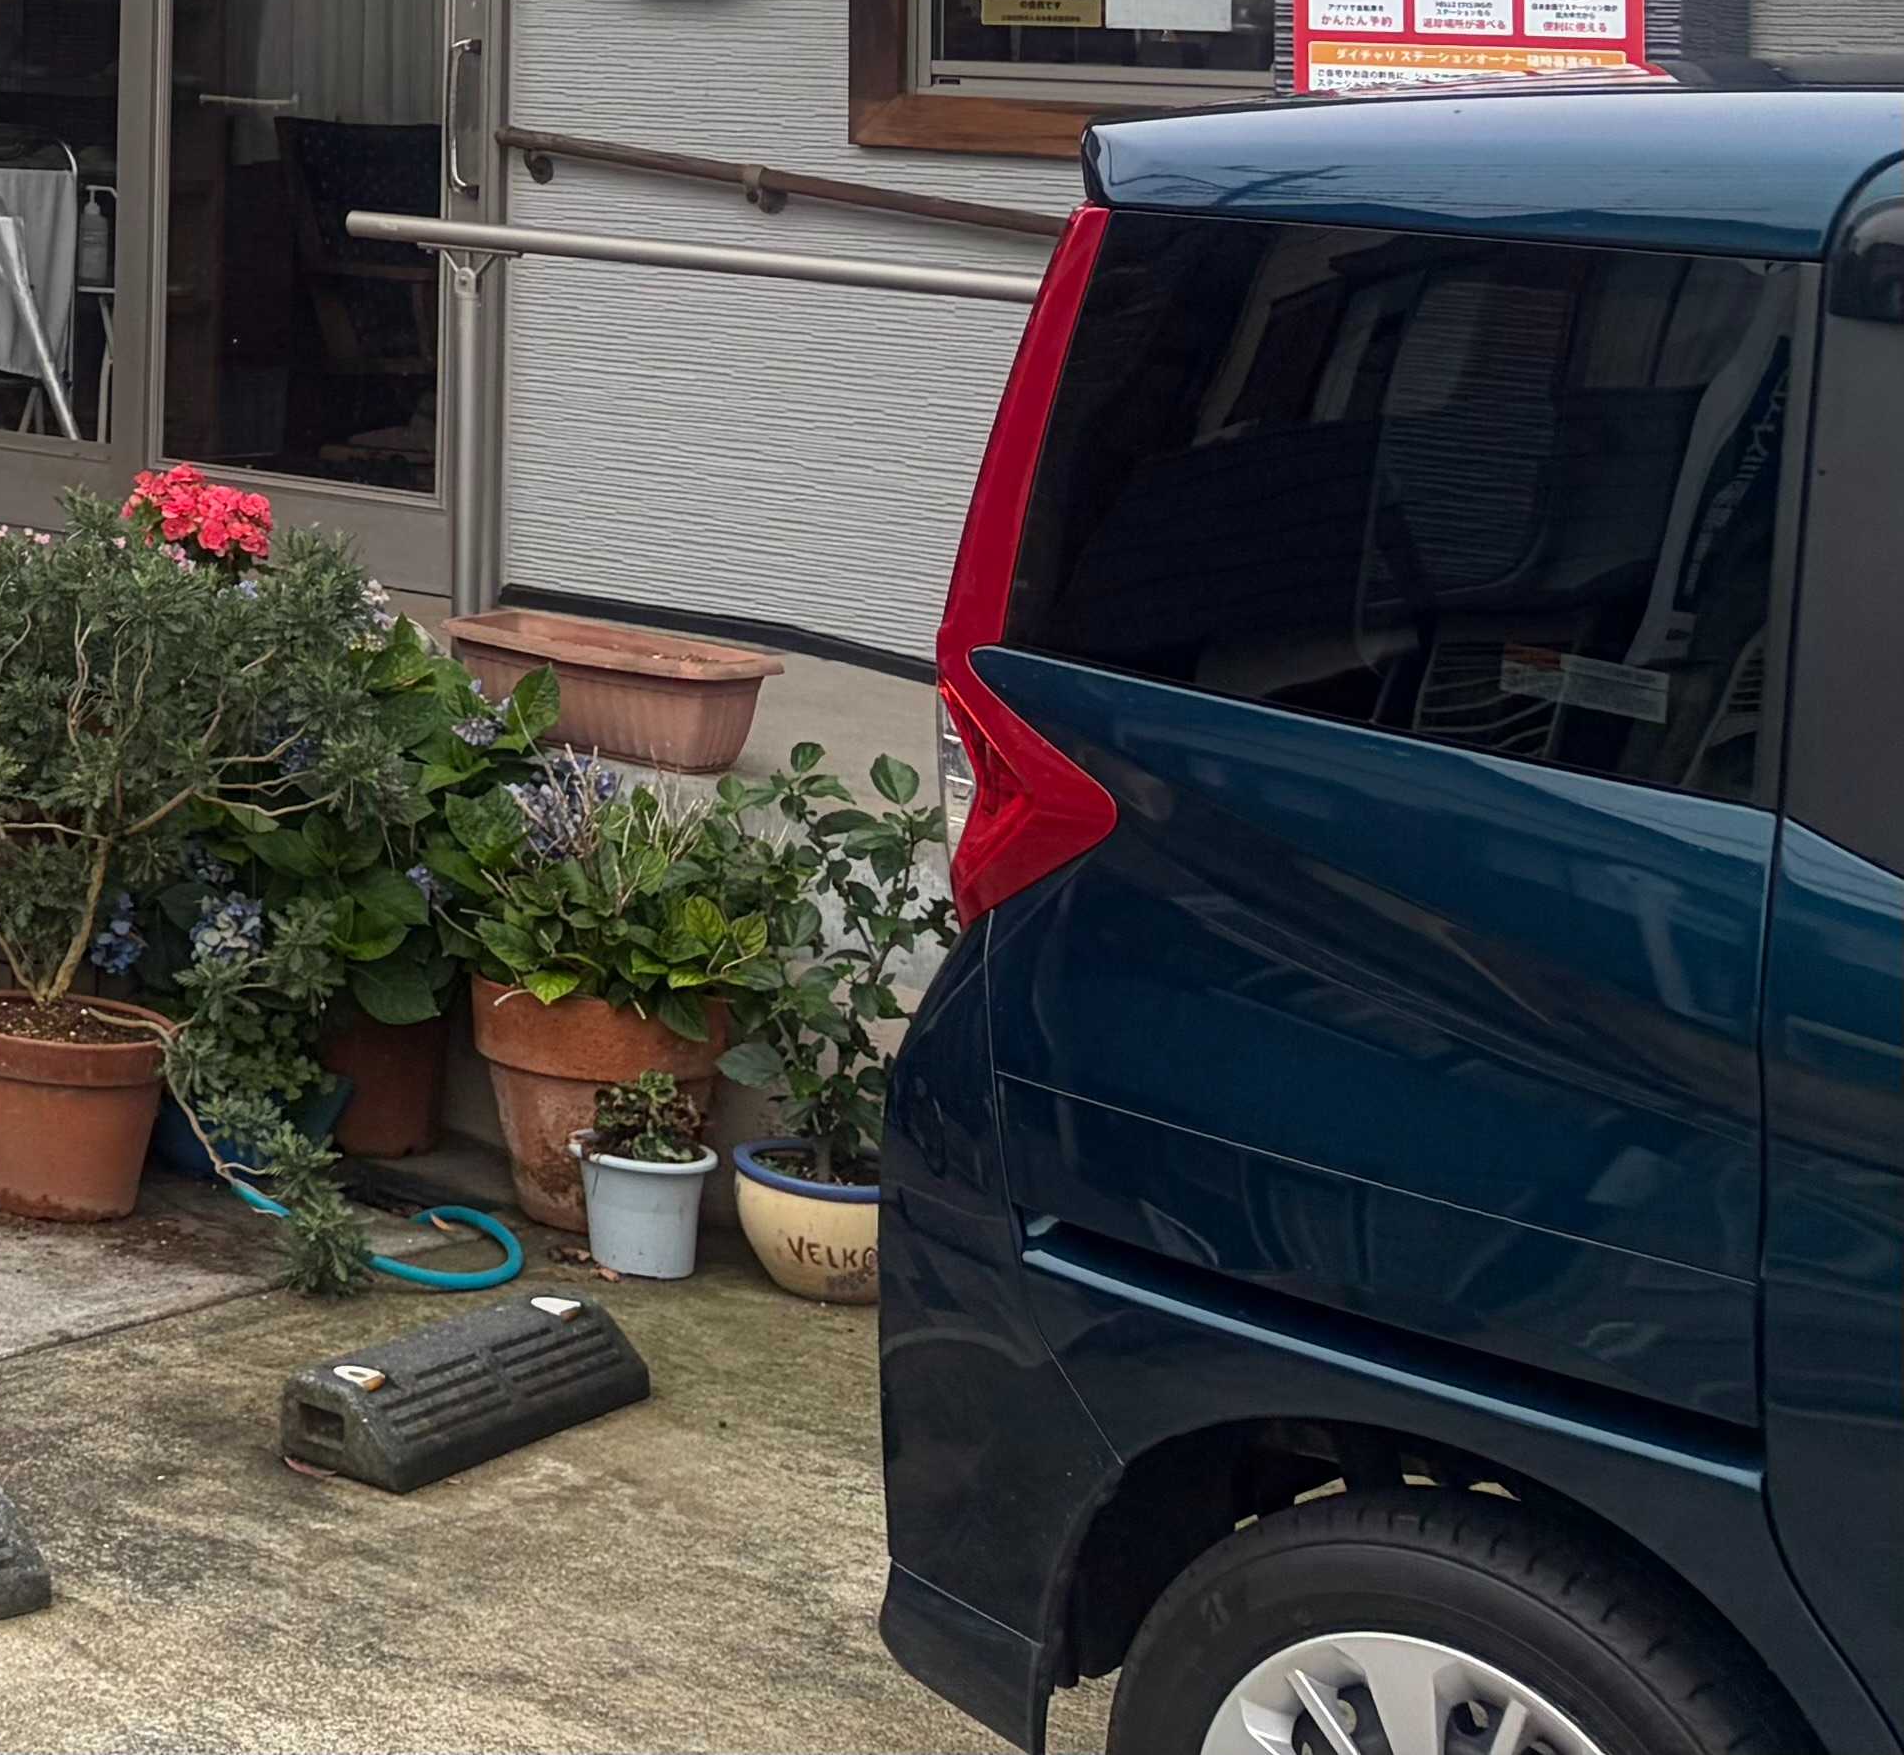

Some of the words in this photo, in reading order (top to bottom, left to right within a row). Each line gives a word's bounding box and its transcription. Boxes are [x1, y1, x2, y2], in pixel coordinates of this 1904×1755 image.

[1321, 15, 1393, 28] かんたん予約
[1543, 21, 1608, 32] 便利に使える
[1336, 49, 1395, 60] ダイチャリ
